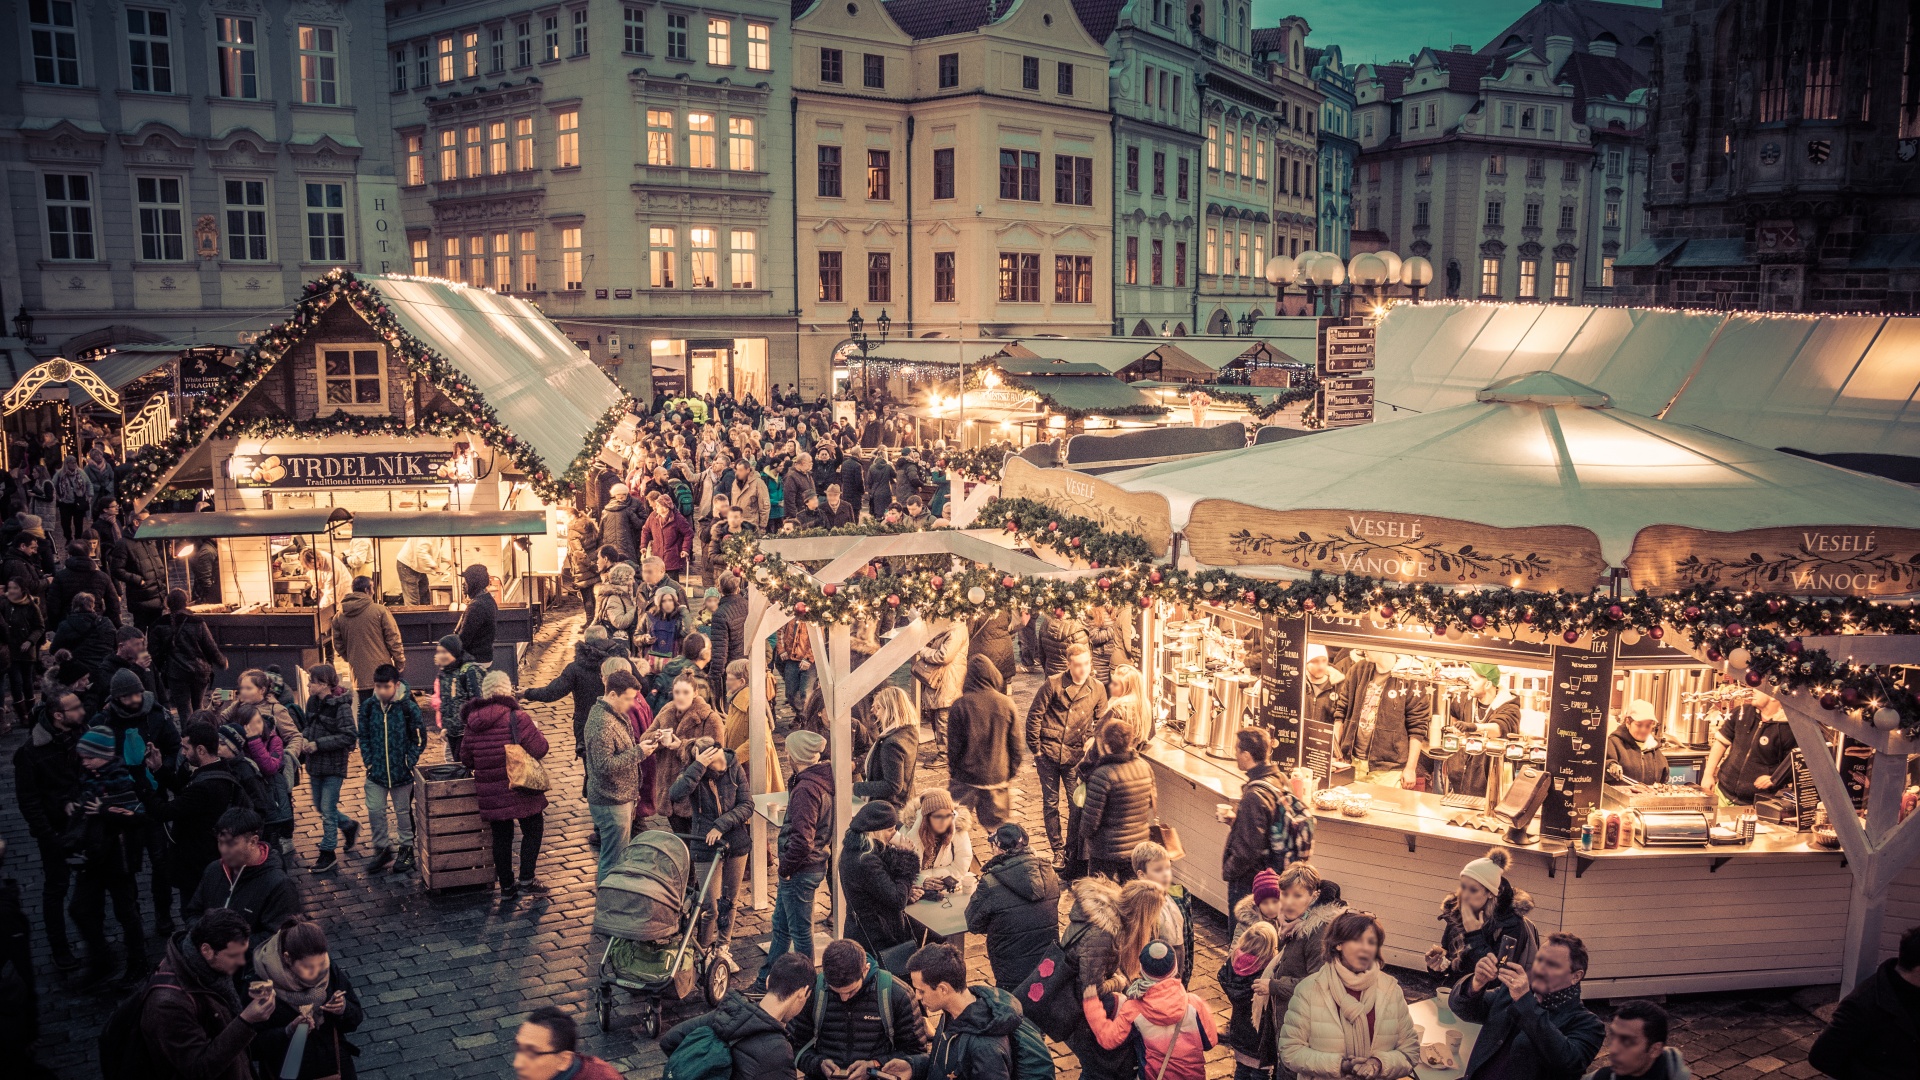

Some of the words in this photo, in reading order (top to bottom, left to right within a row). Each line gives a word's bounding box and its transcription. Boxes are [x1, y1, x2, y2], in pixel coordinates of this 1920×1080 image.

[288, 453, 424, 478] TRDELNÍK
[306, 478, 350, 486] Traditional
[352, 477, 386, 486] chimney
[388, 476, 407, 485] cake
[1339, 552, 1428, 578] VÁNOCE
[1790, 569, 1878, 590] VÁNOCE
[1560, 767, 1574, 775] Latte
[1668, 773, 1686, 784] psi
